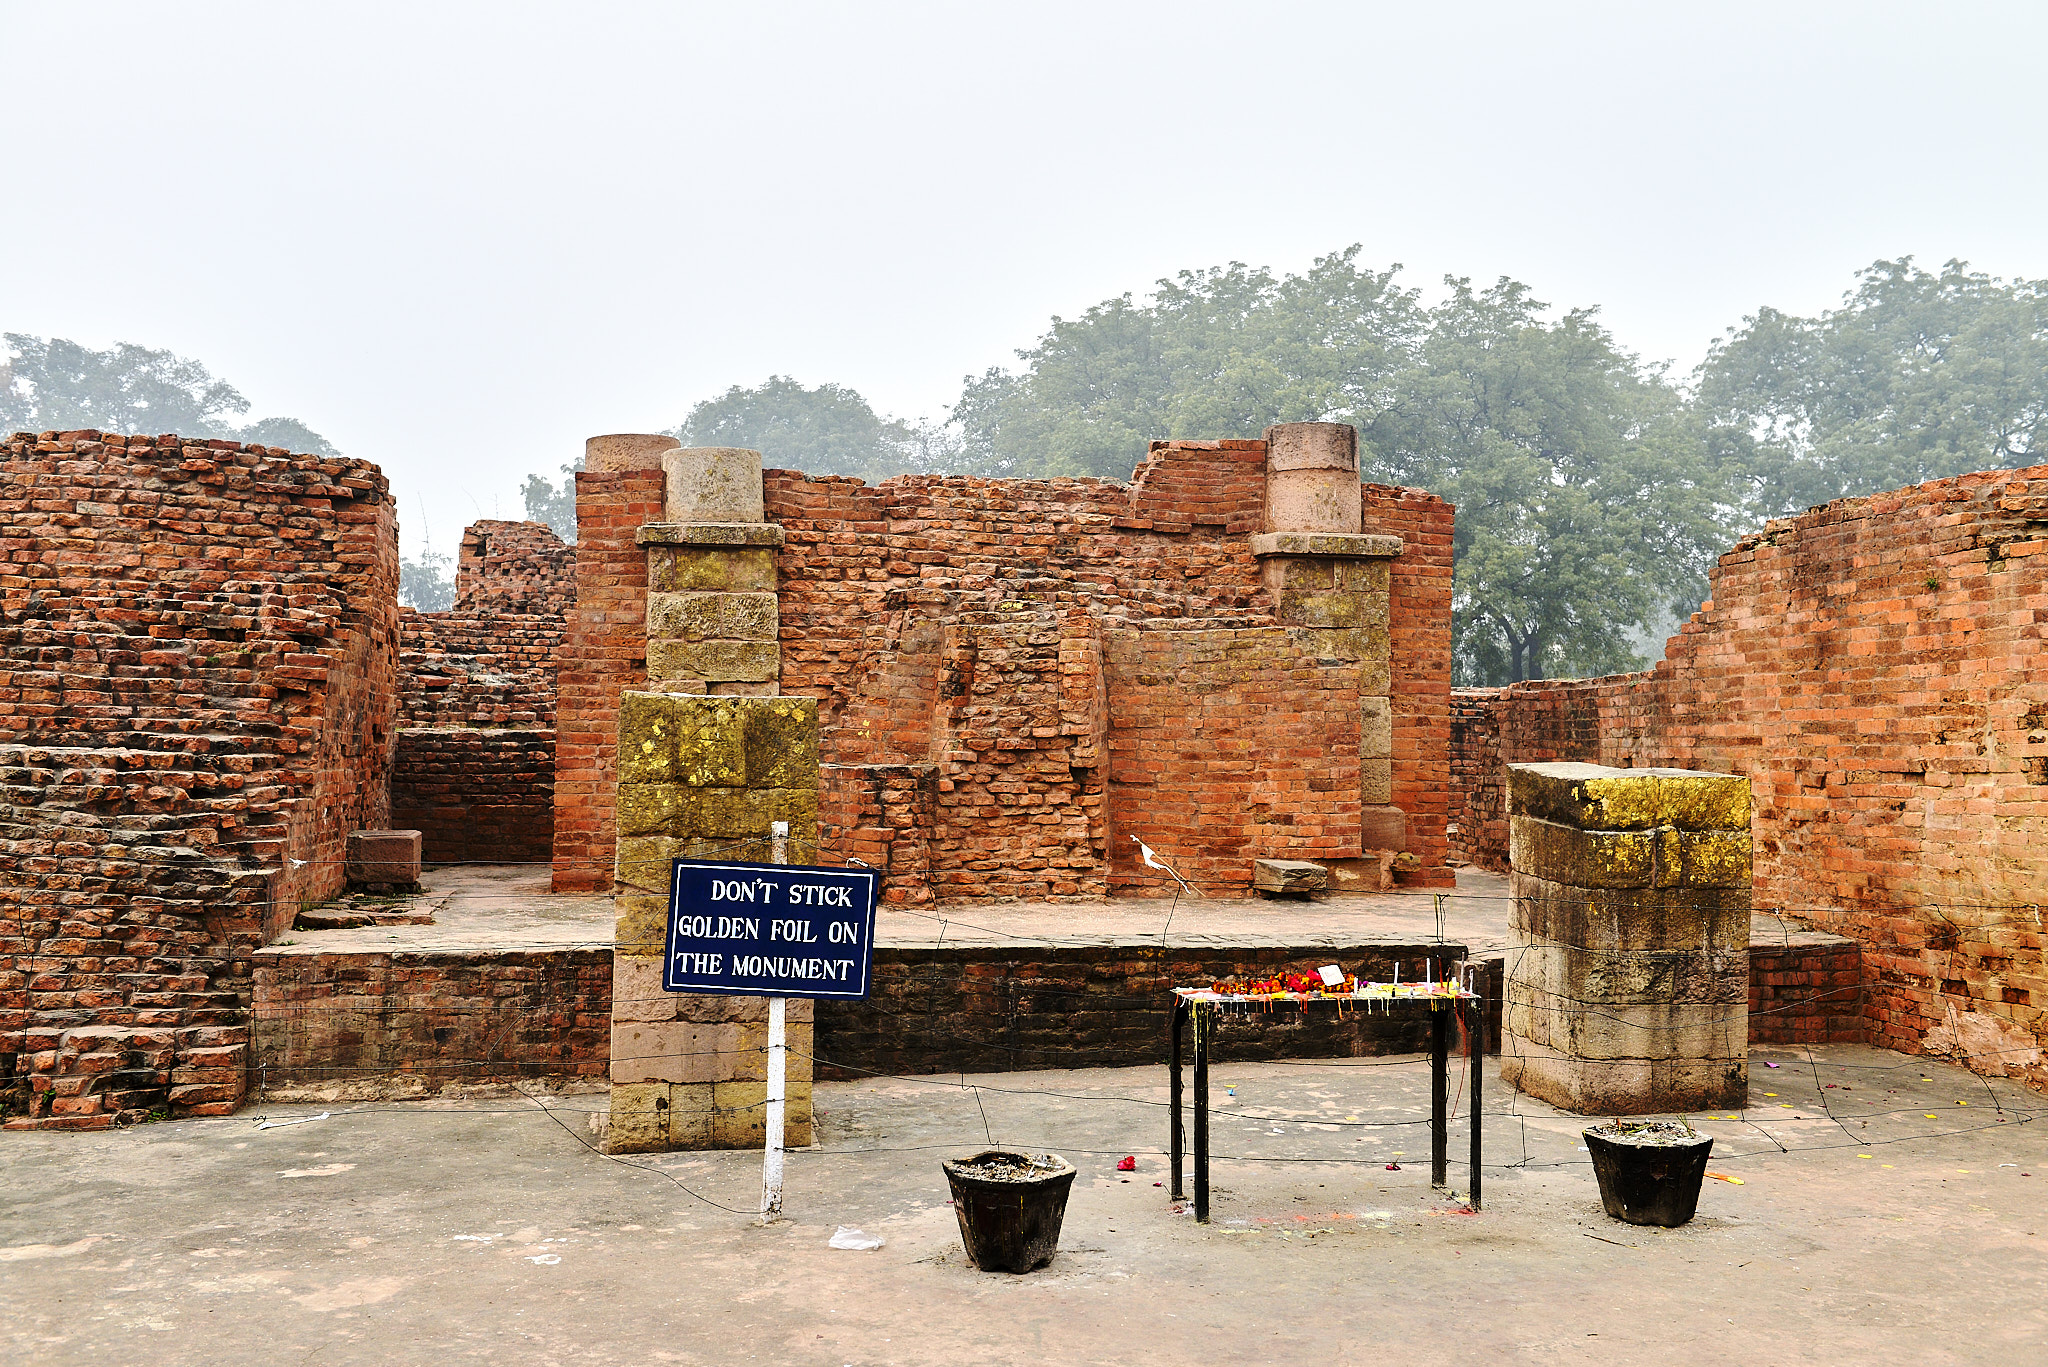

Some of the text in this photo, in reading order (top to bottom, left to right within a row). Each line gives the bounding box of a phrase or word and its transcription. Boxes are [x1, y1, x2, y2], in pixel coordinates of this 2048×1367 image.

[710, 877, 854, 908] DON'T STICK
[678, 915, 859, 945] GOLDEN FOIL ON
[675, 951, 855, 981] THE MONUMENT
